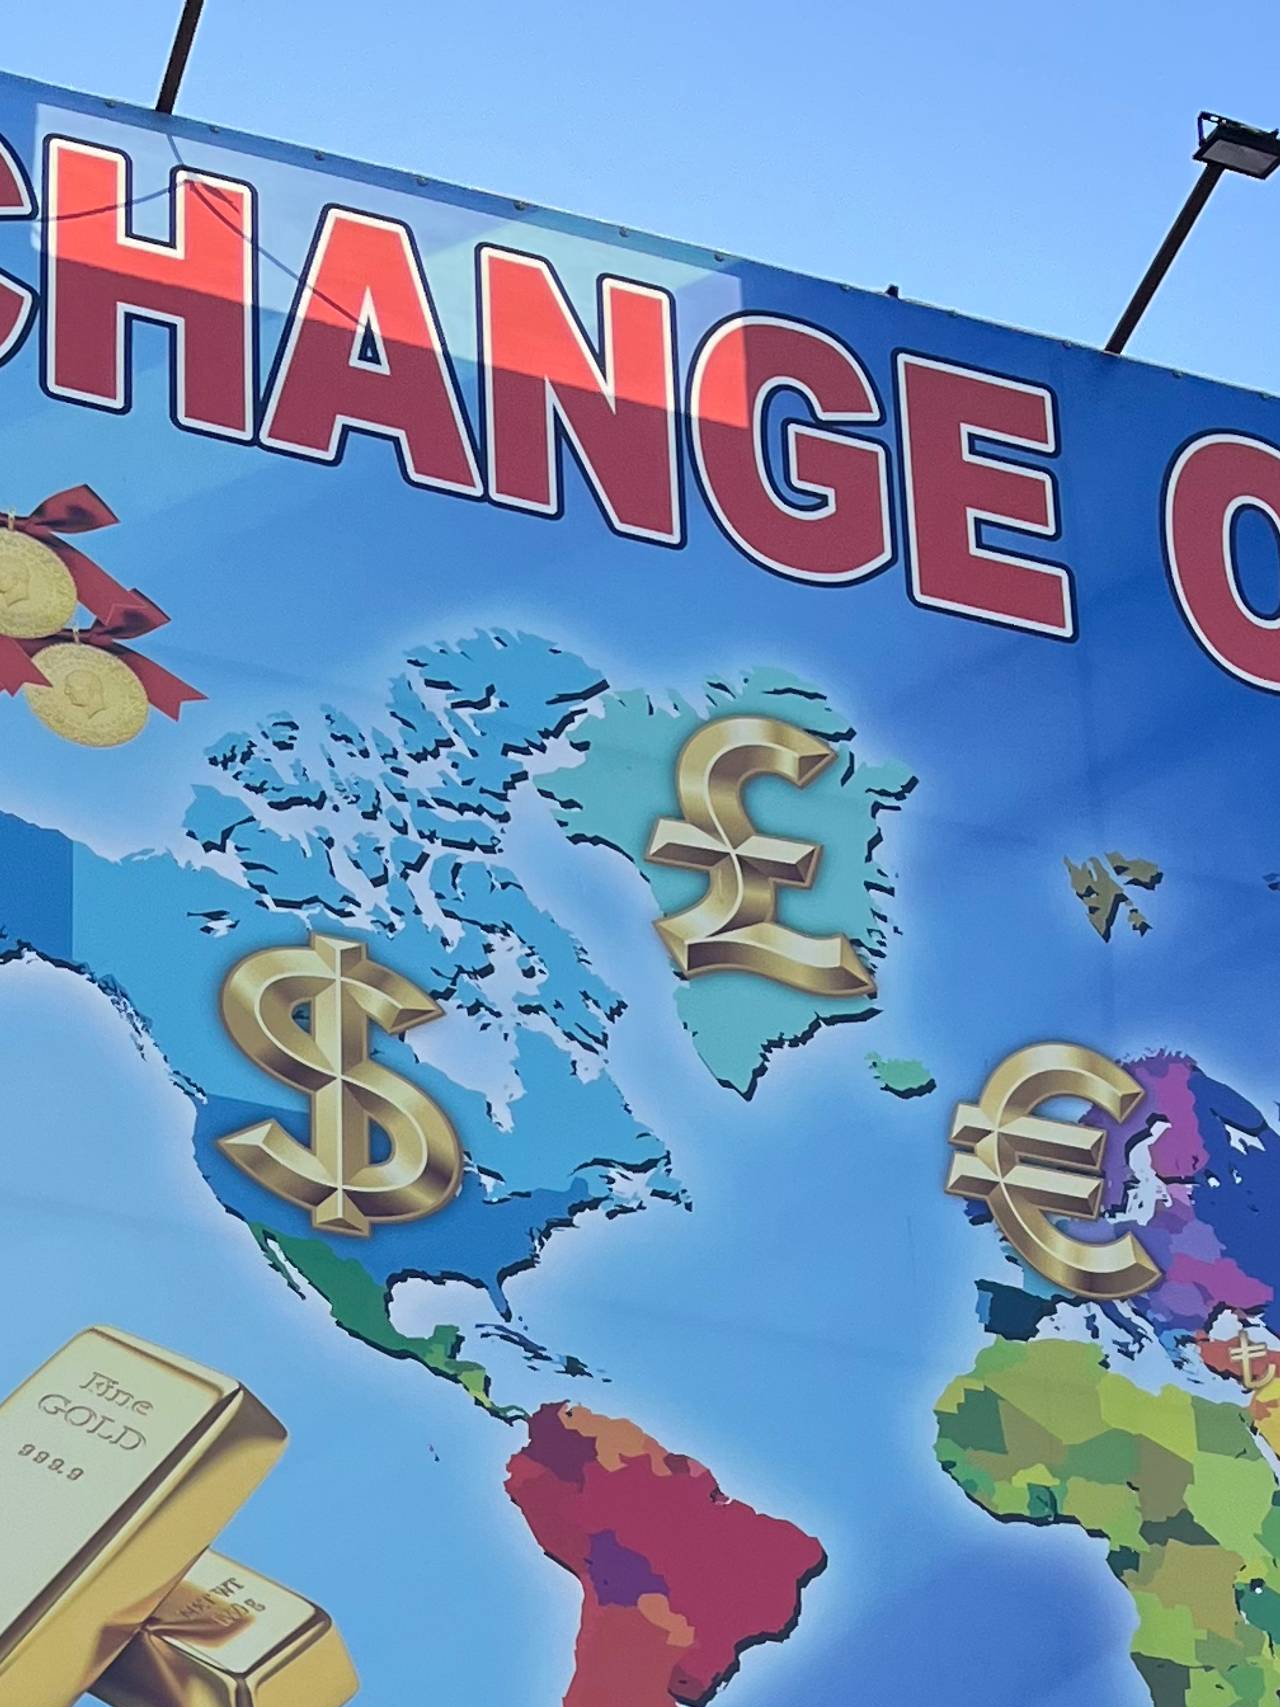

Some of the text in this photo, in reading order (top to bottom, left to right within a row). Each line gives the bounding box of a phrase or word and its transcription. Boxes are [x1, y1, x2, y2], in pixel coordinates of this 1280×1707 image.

[80, 1370, 154, 1417] Fine
[37, 1392, 147, 1452] GOLD
[19, 1442, 84, 1482] 999.9
